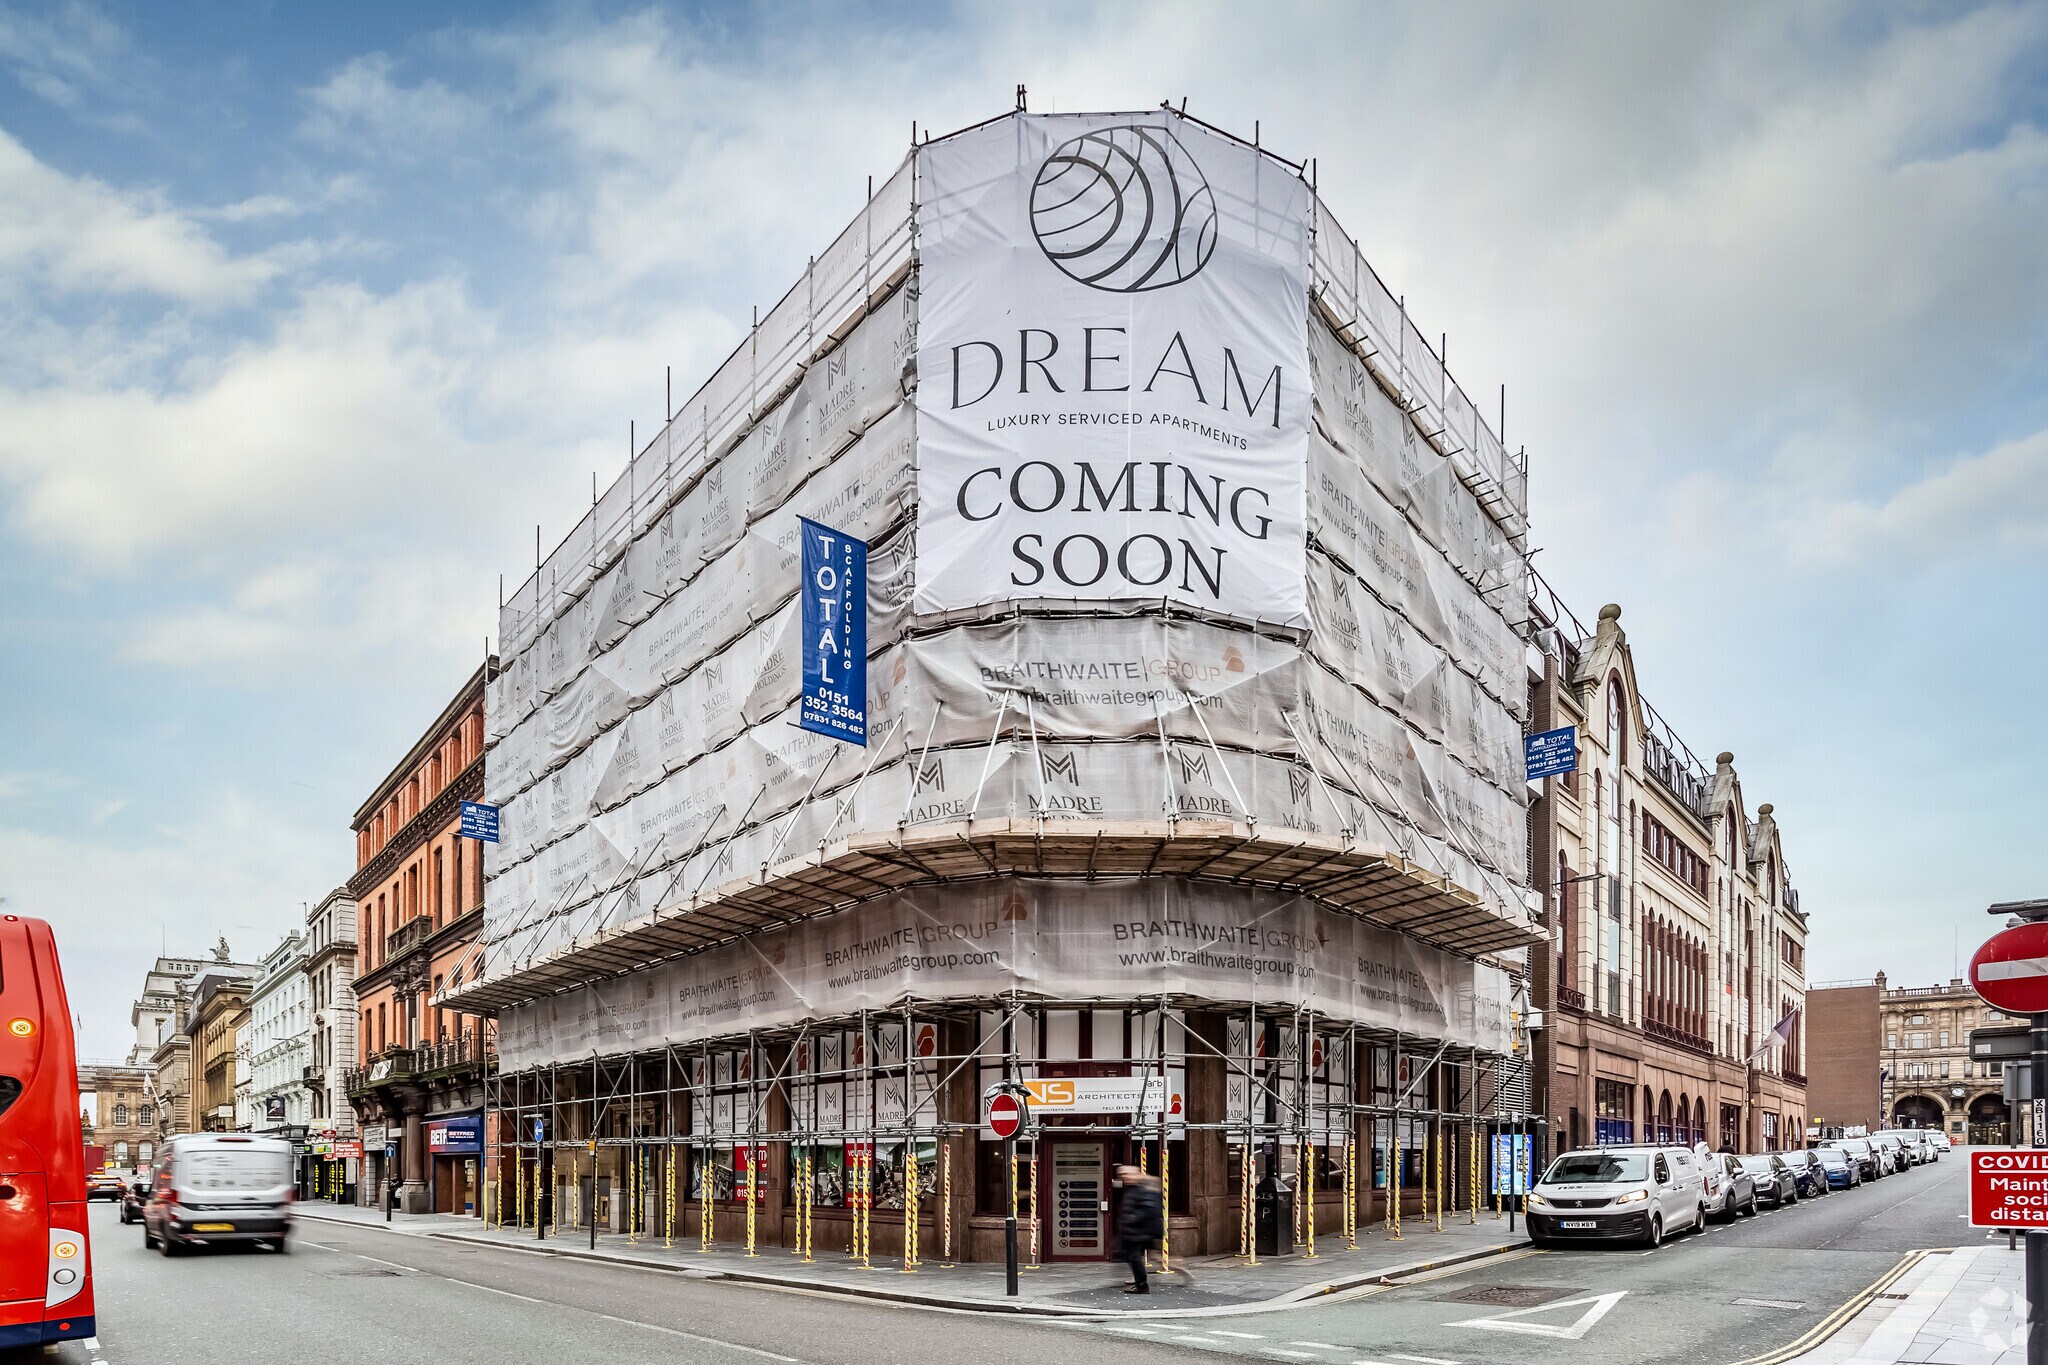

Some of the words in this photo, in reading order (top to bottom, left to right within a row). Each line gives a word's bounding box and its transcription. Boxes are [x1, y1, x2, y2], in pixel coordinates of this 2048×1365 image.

[950, 327, 1284, 430] DREAM
[819, 378, 856, 419] MADRE
[819, 396, 856, 437] HOLDINGS
[987, 413, 1051, 432] LUXURY
[1057, 412, 1143, 426] SERVICED
[1150, 413, 1248, 451] APARTMENTS
[753, 438, 787, 475] MADRE
[777, 479, 860, 550] BRAHWAITE
[863, 437, 911, 487] GROUP
[956, 460, 1273, 540] COMING
[702, 496, 729, 526] MADRE
[1321, 473, 1385, 549] BRAITHWAITE
[1388, 535, 1421, 574] GROUP
[656, 541, 681, 568] MADRE
[1010, 533, 1228, 599] SOON
[816, 535, 838, 684] TOTAL
[843, 544, 852, 670] SCAFFOLDING
[649, 605, 701, 657] BRAITHWAITE
[753, 648, 785, 680] MADRE
[754, 666, 787, 692] HOLDINGS
[980, 661, 1139, 683] BRAITHWAITE
[1149, 659, 1222, 683] GROUP
[703, 689, 732, 712] MADRE
[805, 695, 830, 714] 352
[832, 702, 864, 723] 3564
[819, 687, 849, 706] 0151
[658, 720, 683, 742] MADRE
[804, 711, 829, 725] 07831
[831, 718, 847, 730] 826
[848, 723, 864, 735] 482
[1547, 734, 1572, 744] TOTAL
[615, 746, 639, 767] MADRE
[640, 796, 692, 834] BRAITHWAITE
[903, 799, 966, 823] MADRE
[1028, 794, 1104, 811] MADRE
[1168, 795, 1232, 814] MADRE
[825, 928, 915, 967] BRAITHWAITE
[920, 921, 998, 943] GROUP
[1113, 919, 1259, 946] BRAITHWAITE
[1266, 930, 1315, 955] GROUP
[828, 950, 1000, 989] www.braithwaitegroup.com
[1118, 946, 1317, 980] www.braithwaitegroup.com
[1358, 957, 1418, 990] BRAITHWAITE
[679, 977, 738, 1003] BRAITHWAITE
[742, 966, 772, 985] GROUP
[578, 1005, 617, 1026] BRAITHWAITE
[619, 1000, 646, 1015] GROUP
[682, 990, 776, 1021] www.braithwaitegroup.com
[819, 1114, 842, 1122] MADRE
[878, 1111, 904, 1120] MADRE
[1990, 1207, 2048, 1221] dista
